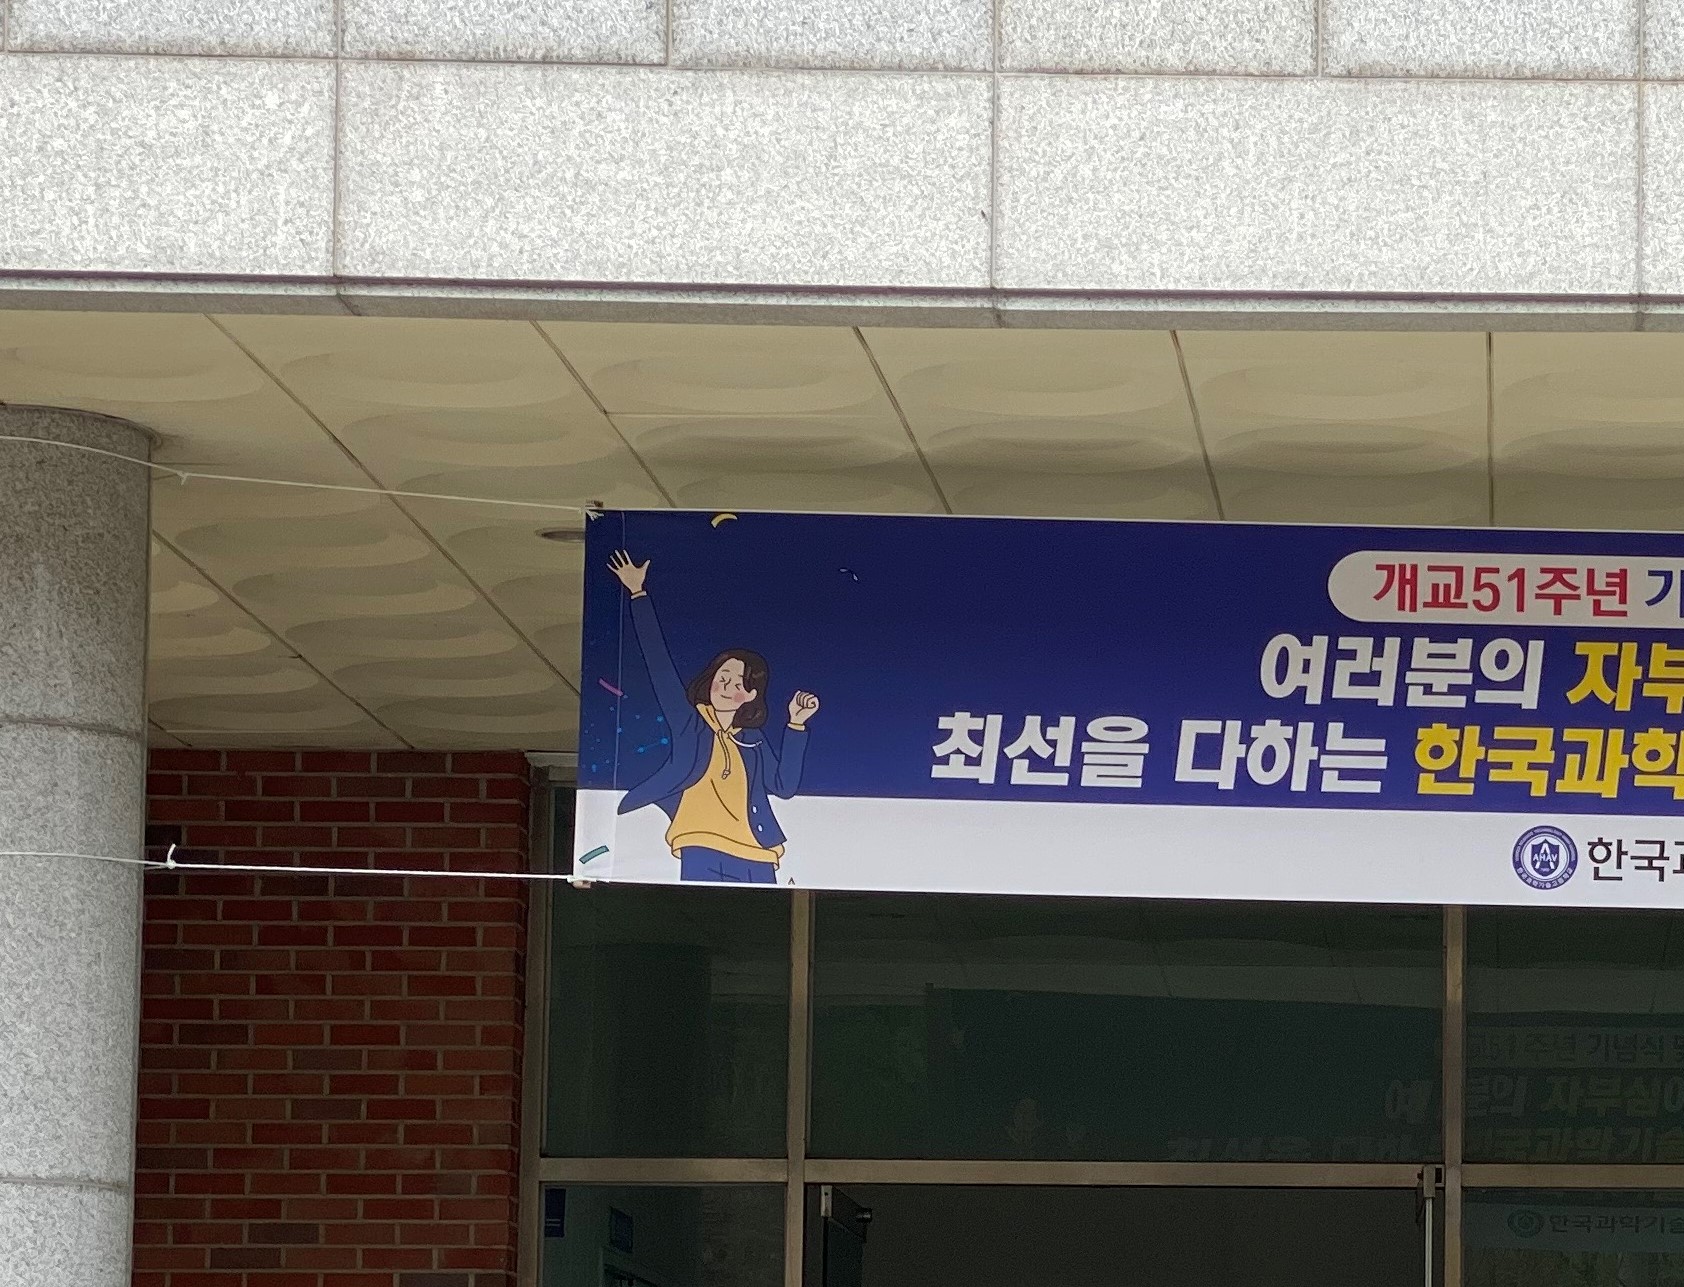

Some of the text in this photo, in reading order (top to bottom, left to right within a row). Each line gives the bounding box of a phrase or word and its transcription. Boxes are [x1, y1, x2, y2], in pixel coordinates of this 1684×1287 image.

[1373, 561, 1630, 618] 개교51주년
[1259, 633, 1546, 711] 여러분의
[930, 711, 1151, 789] 최선을
[1174, 718, 1388, 794] 다하는
